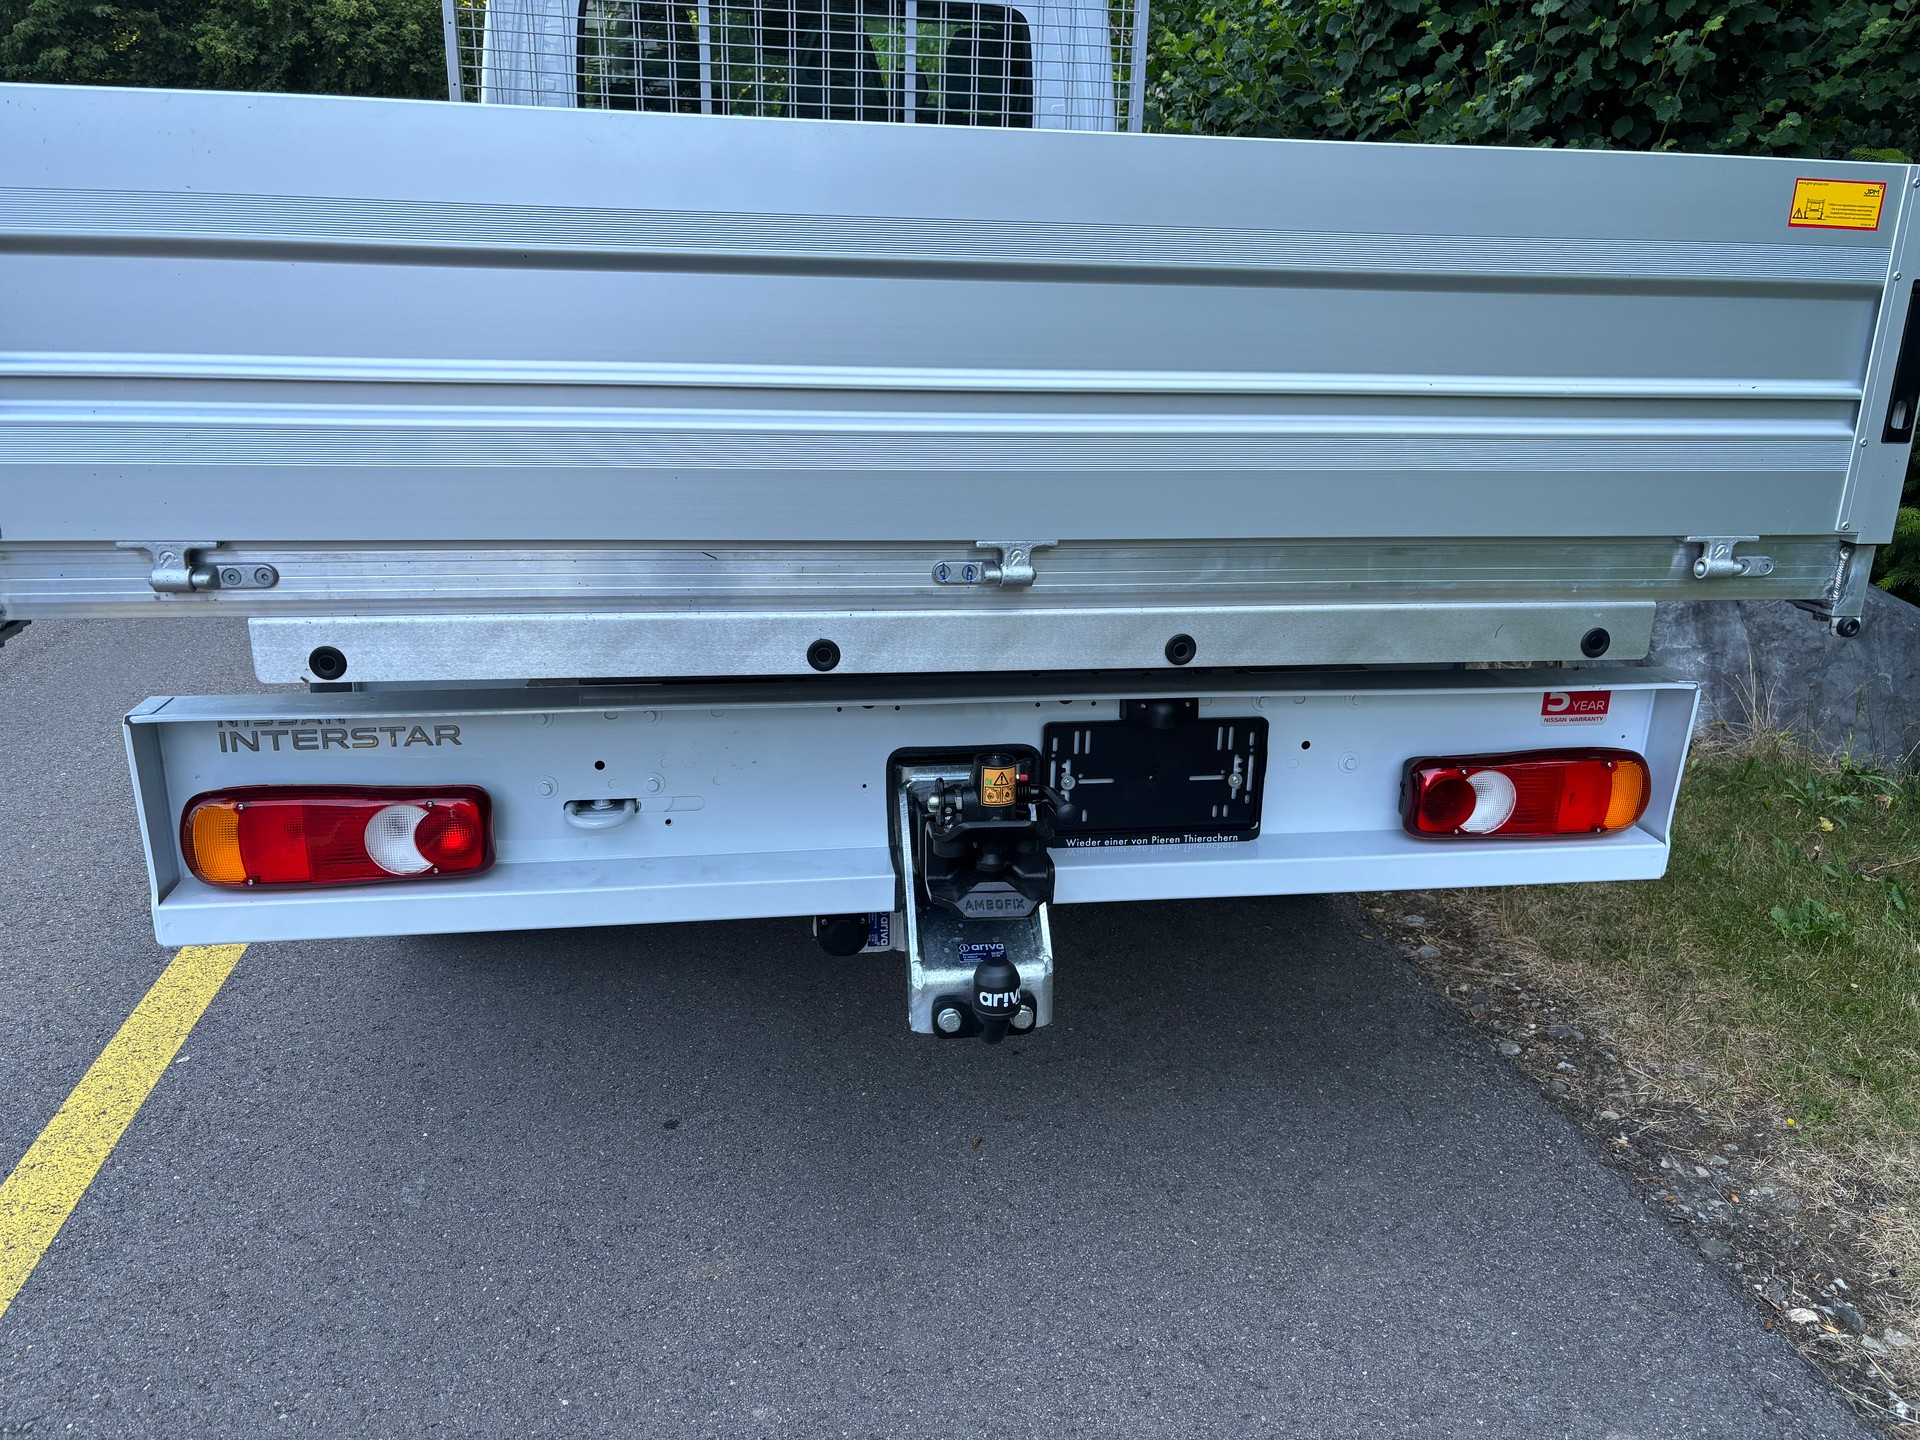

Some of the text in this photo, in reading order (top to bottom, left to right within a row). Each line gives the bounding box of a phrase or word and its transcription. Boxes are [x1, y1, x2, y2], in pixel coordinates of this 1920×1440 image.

[1546, 692, 1605, 712] 5 YEAR
[218, 724, 463, 753] INTERSTAR
[1065, 838, 1101, 847] Wieder
[1104, 838, 1128, 846] einer
[1151, 835, 1180, 845] Pieren
[1183, 833, 1238, 843] Thierachern
